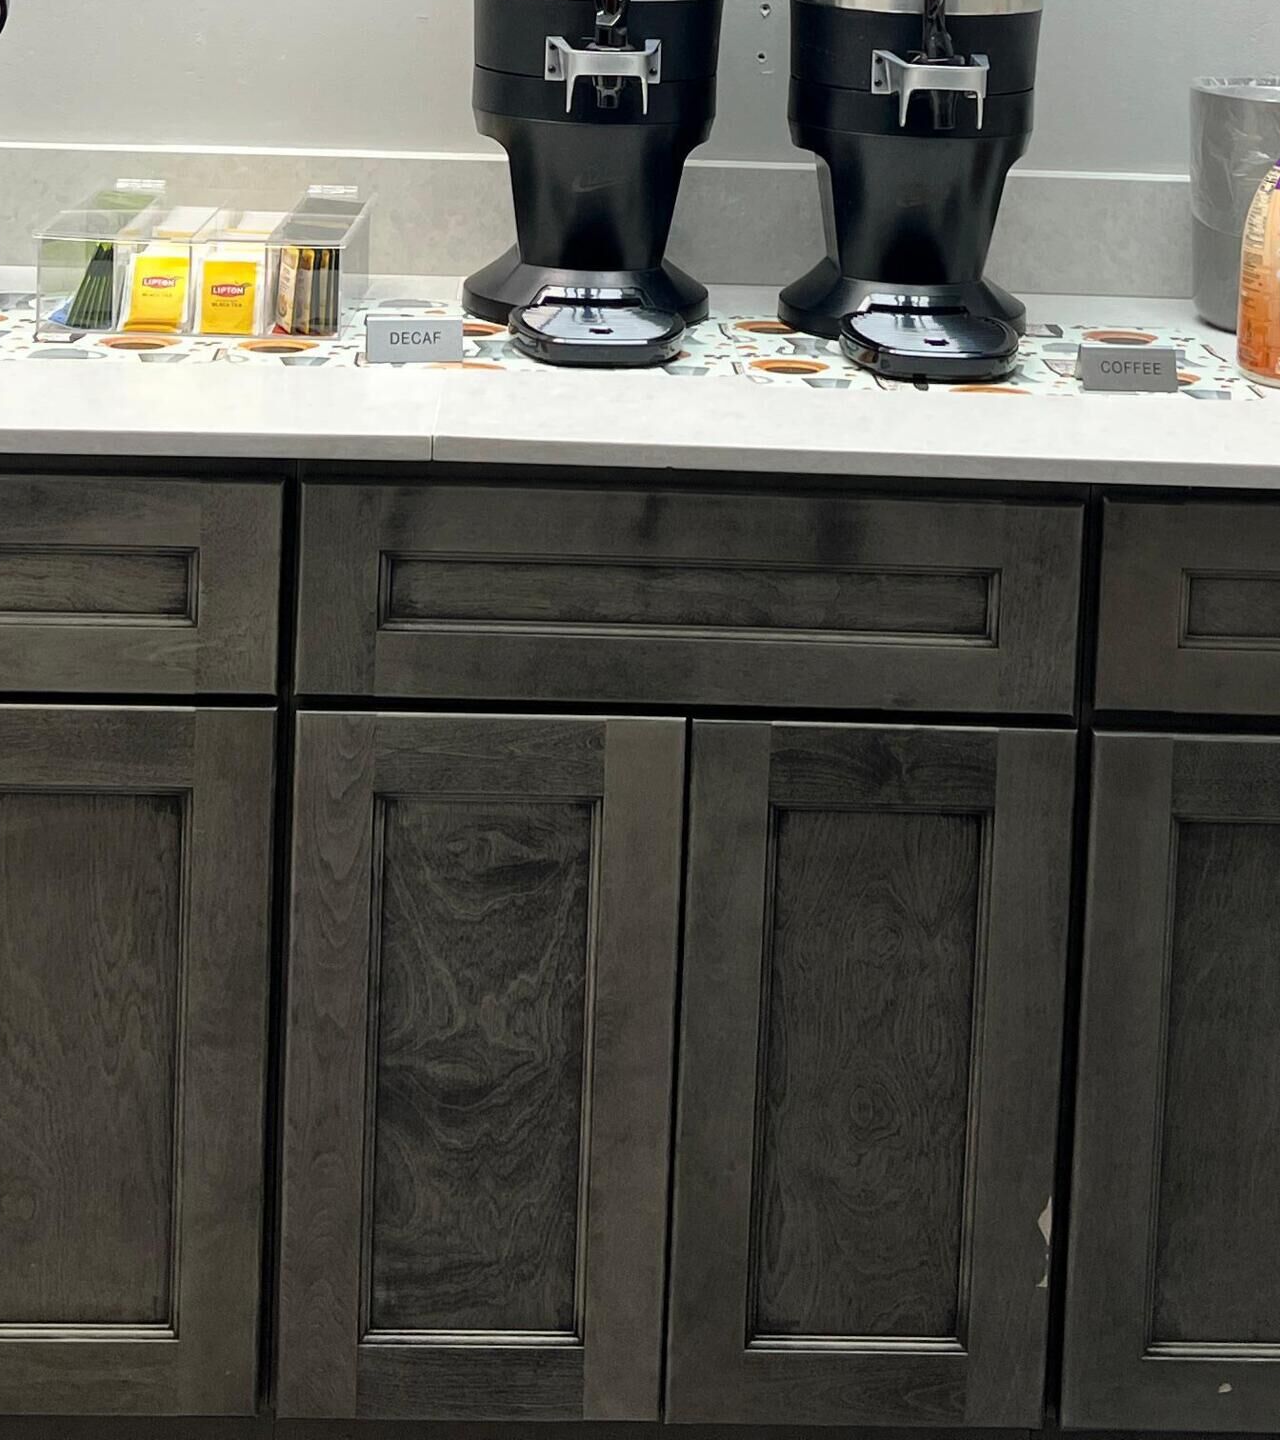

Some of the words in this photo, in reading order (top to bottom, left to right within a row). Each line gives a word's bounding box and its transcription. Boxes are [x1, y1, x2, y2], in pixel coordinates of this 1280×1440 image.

[143, 278, 174, 287] LIPTON
[212, 286, 244, 295] LIPTON
[389, 331, 441, 345] DECAF
[1100, 360, 1162, 375] COFFEE
